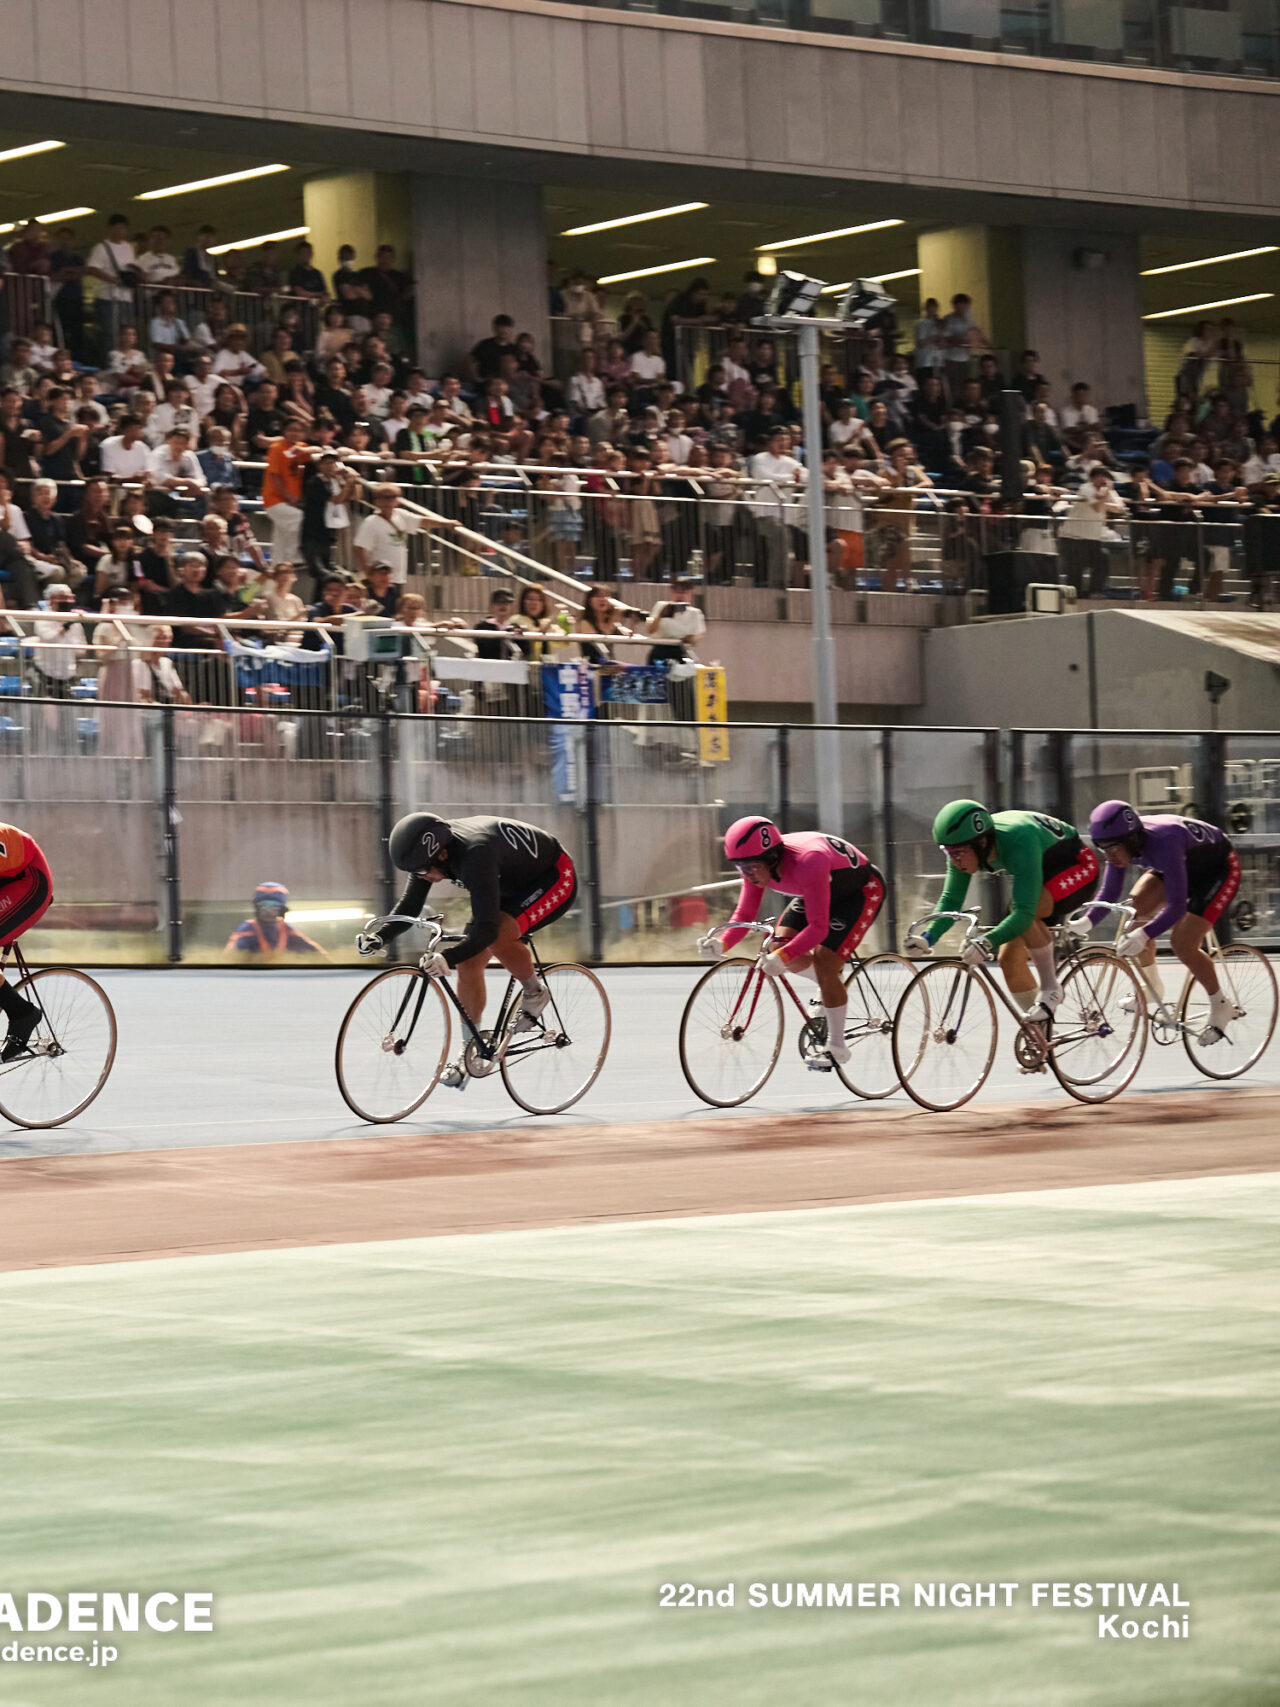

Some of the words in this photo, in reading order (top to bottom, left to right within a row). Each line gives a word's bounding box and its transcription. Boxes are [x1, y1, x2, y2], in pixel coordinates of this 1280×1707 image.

[972, 812, 984, 834] 6
[422, 831, 440, 858] 2
[497, 820, 539, 859] 2
[761, 827, 771, 849] 8
